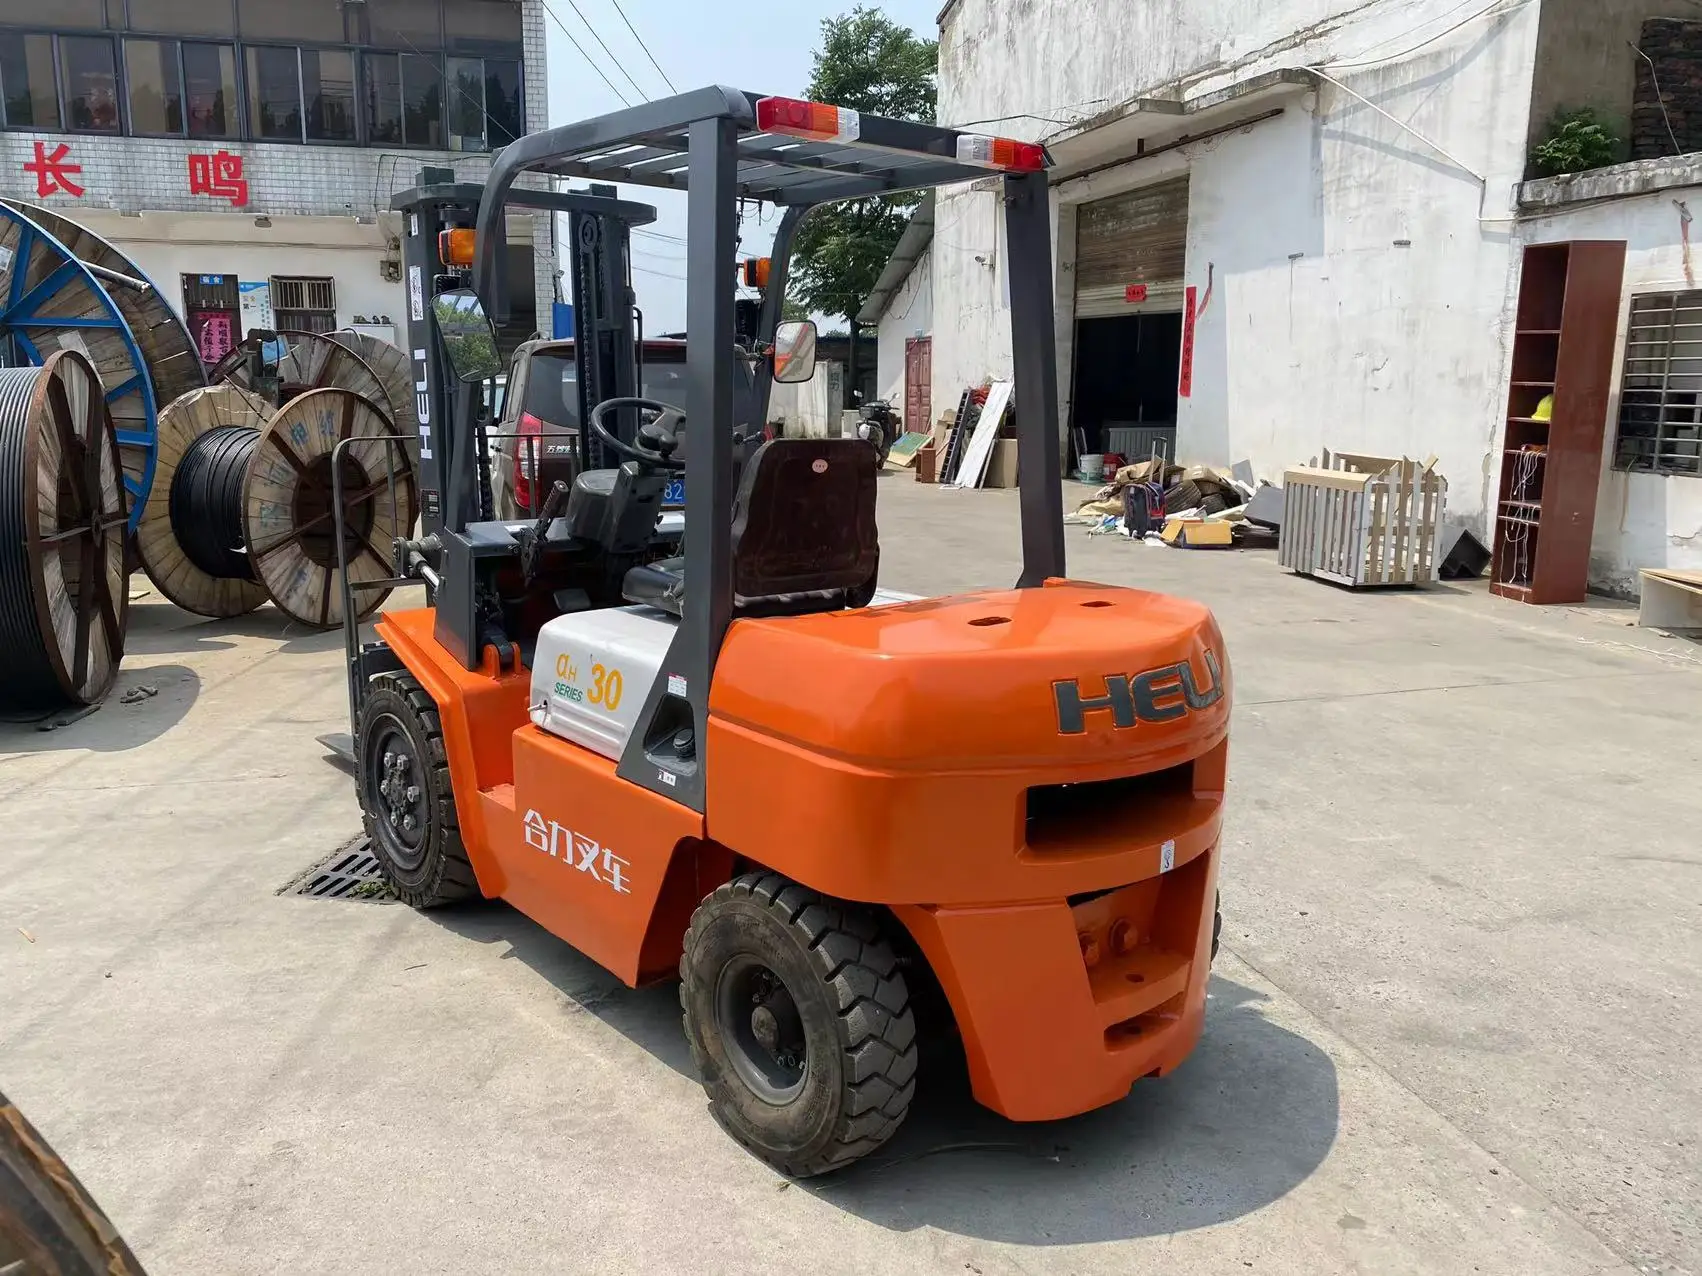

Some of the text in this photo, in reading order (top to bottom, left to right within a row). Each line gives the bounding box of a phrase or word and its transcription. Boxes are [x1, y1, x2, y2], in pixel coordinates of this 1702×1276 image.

[414, 349, 432, 459] HELI
[554, 682, 583, 702] SERIES
[587, 663, 623, 711] 30
[523, 808, 632, 894] 合力叉车
